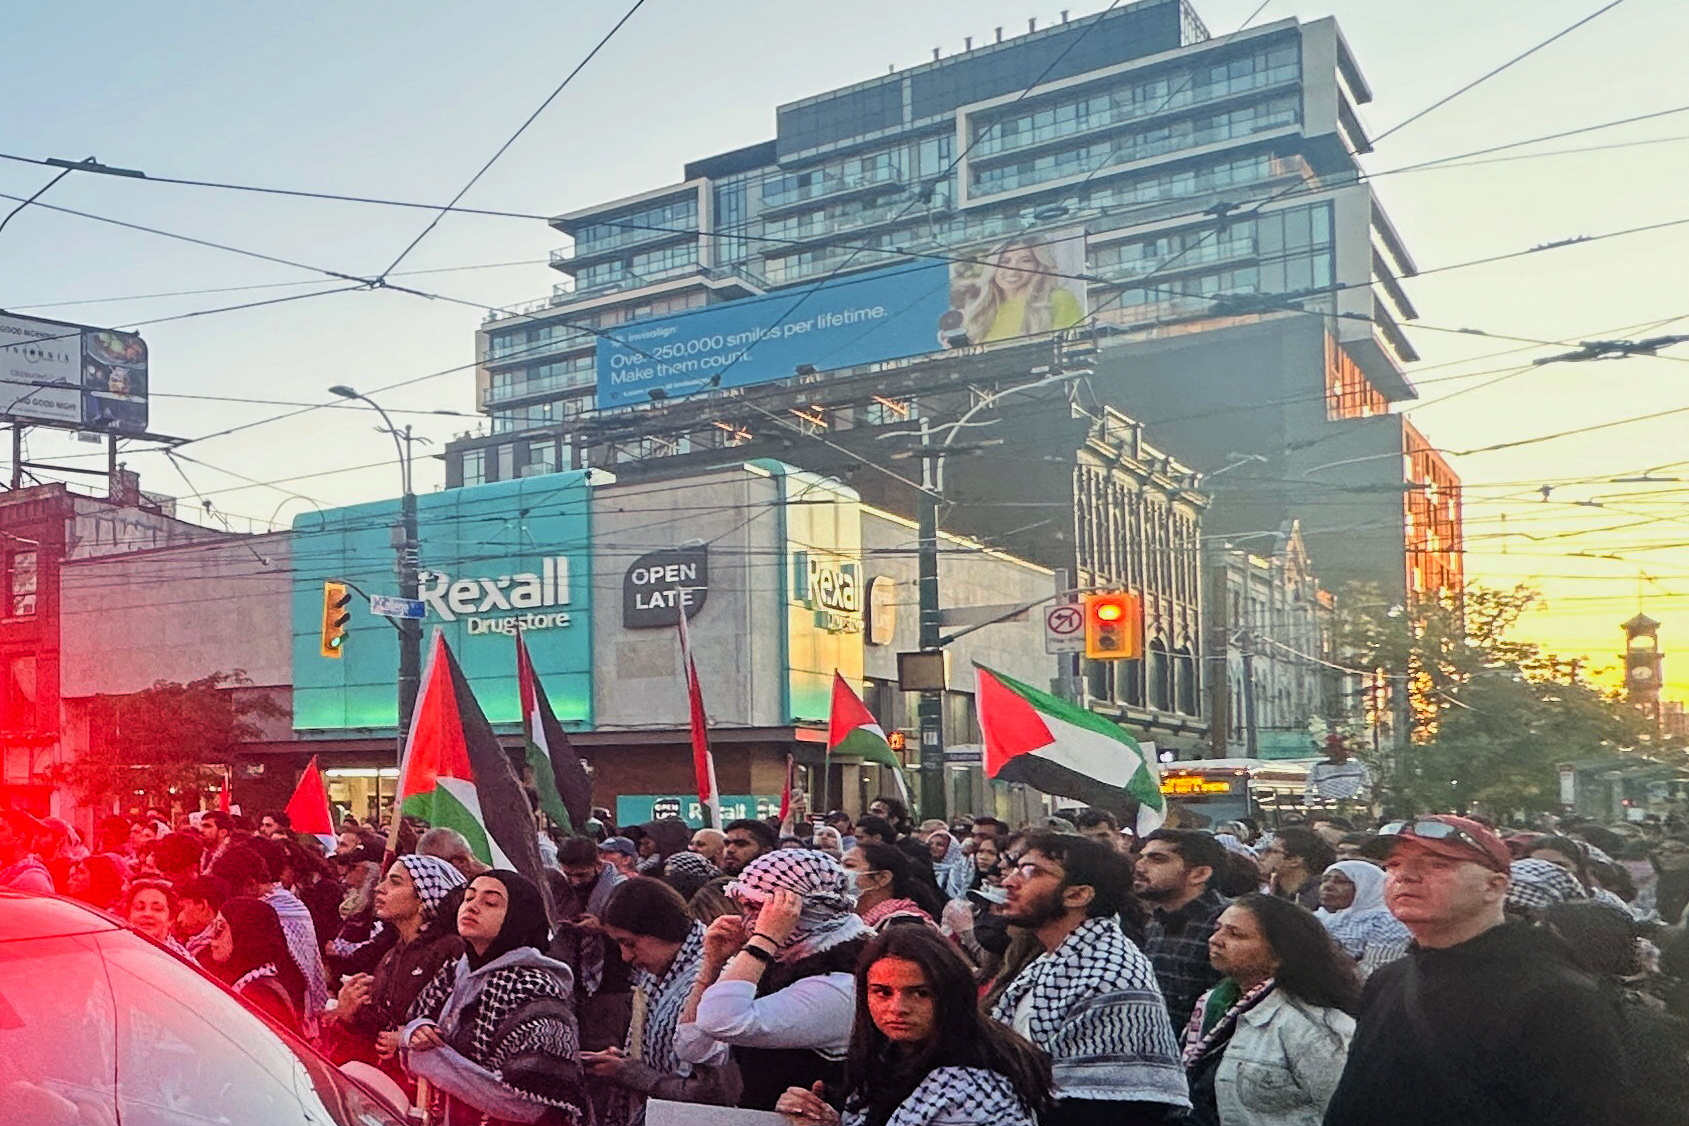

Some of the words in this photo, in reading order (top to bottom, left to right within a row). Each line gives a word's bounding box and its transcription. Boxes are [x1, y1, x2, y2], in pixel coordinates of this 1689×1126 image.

[784, 318, 815, 339] per
[817, 305, 889, 330] lifetime.
[610, 367, 654, 385] Make
[656, 358, 698, 377] them
[632, 563, 696, 585] OPEN
[417, 556, 570, 621] Rexall
[635, 589, 693, 610] LATE
[467, 612, 570, 636] Drugstore
